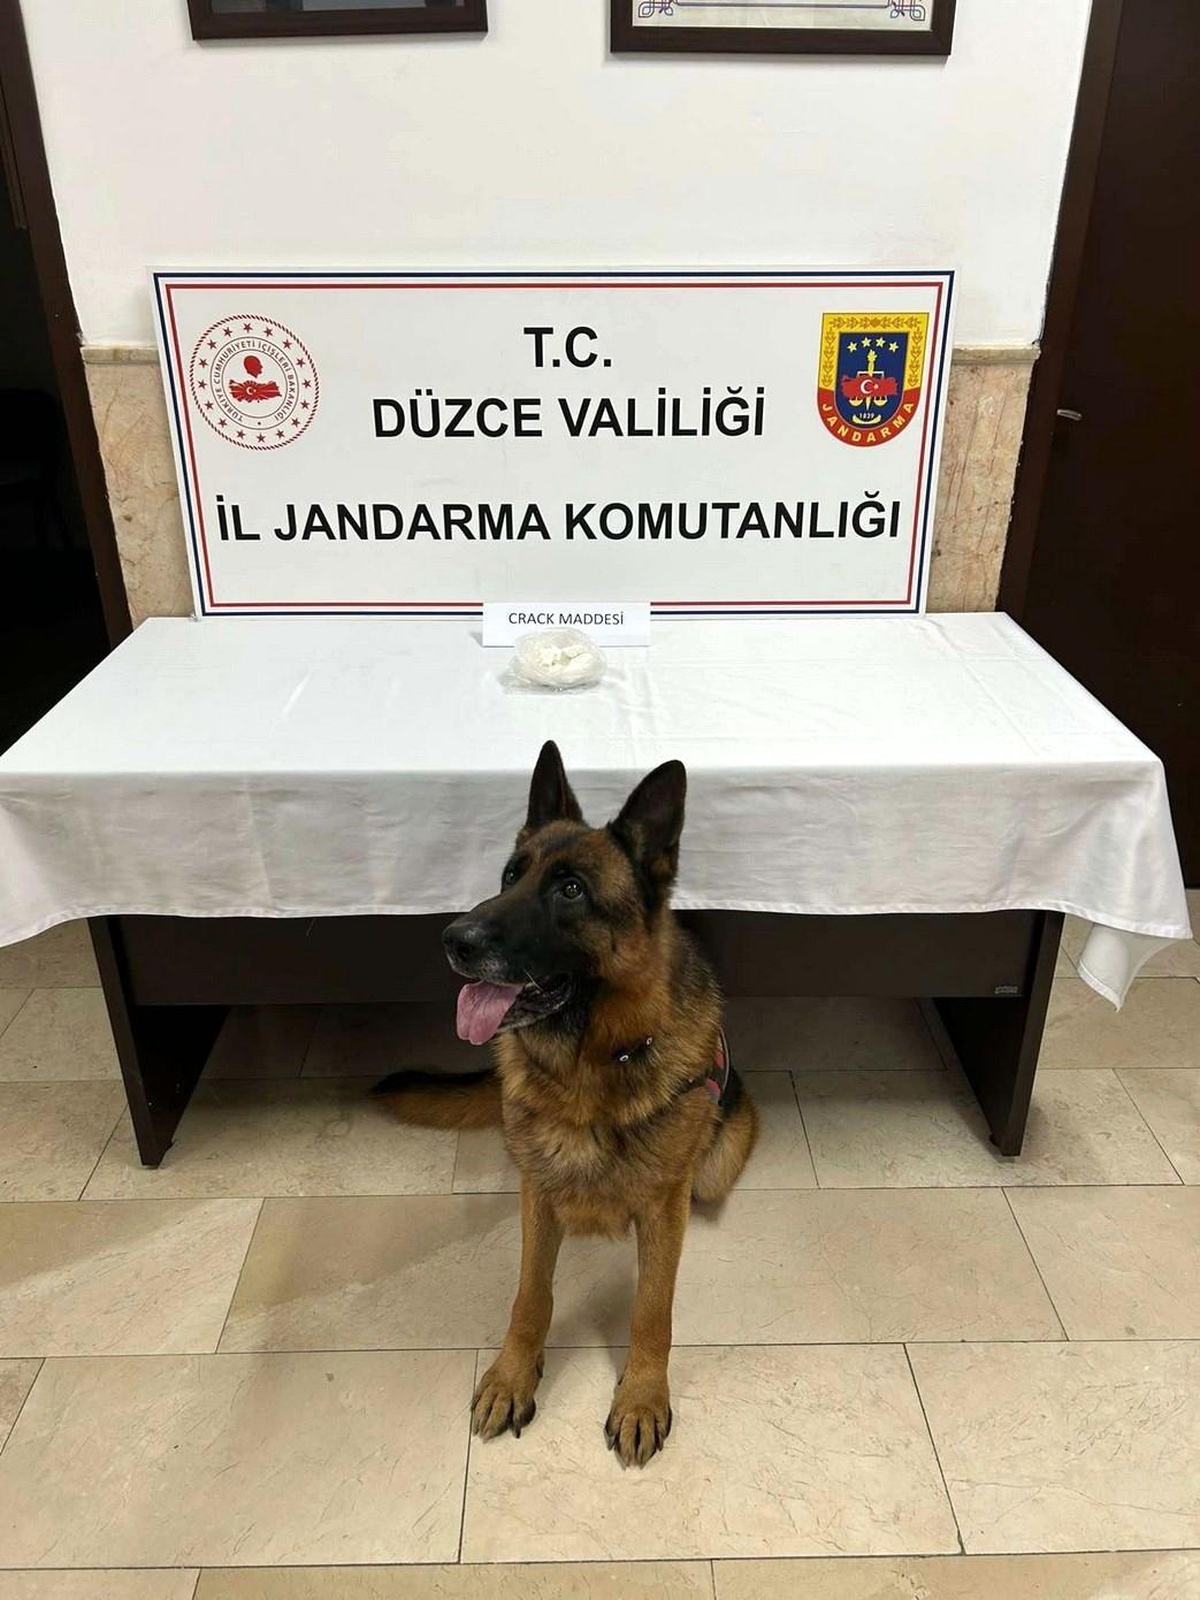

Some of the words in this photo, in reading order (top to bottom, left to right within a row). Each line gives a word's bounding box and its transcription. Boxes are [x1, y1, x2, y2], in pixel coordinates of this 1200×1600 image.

[214, 340, 255, 384] CUMHURİYETİ
[523, 326, 612, 368] T.C.
[214, 387, 243, 422] TÜRKİYE
[274, 375, 296, 421] BAKANLIĞI
[372, 388, 543, 438] DÜZCE
[557, 386, 765, 437] VALİLİĞİ
[821, 402, 914, 443] JANDARMA
[216, 494, 261, 541] İL
[274, 503, 551, 541] JANDARMA
[565, 490, 901, 541] KOMUTANLIĞI
[508, 612, 555, 625] CRACK
[559, 611, 624, 625] MADDESİ
